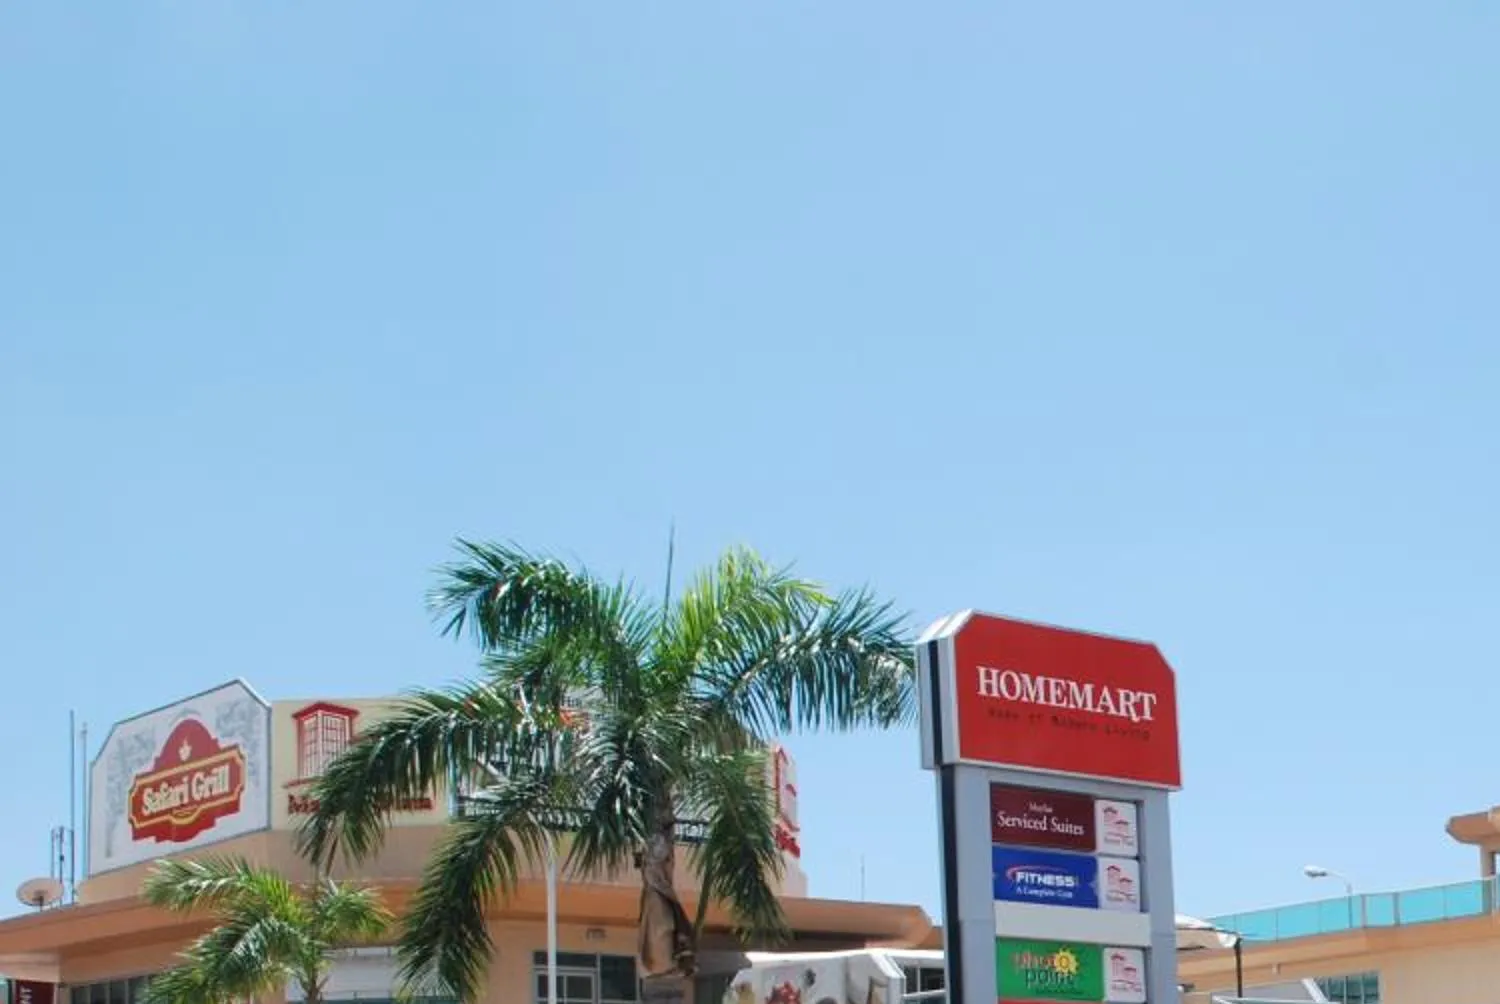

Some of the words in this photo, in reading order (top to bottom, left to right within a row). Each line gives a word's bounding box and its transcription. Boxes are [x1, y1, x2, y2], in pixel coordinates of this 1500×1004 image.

[976, 666, 1157, 722] HOMEMART
[142, 777, 190, 816] Safari
[192, 764, 231, 797] Grill
[997, 811, 1047, 832] Serviced
[1051, 816, 1084, 836] Suites
[1016, 871, 1075, 888] FITNESS
